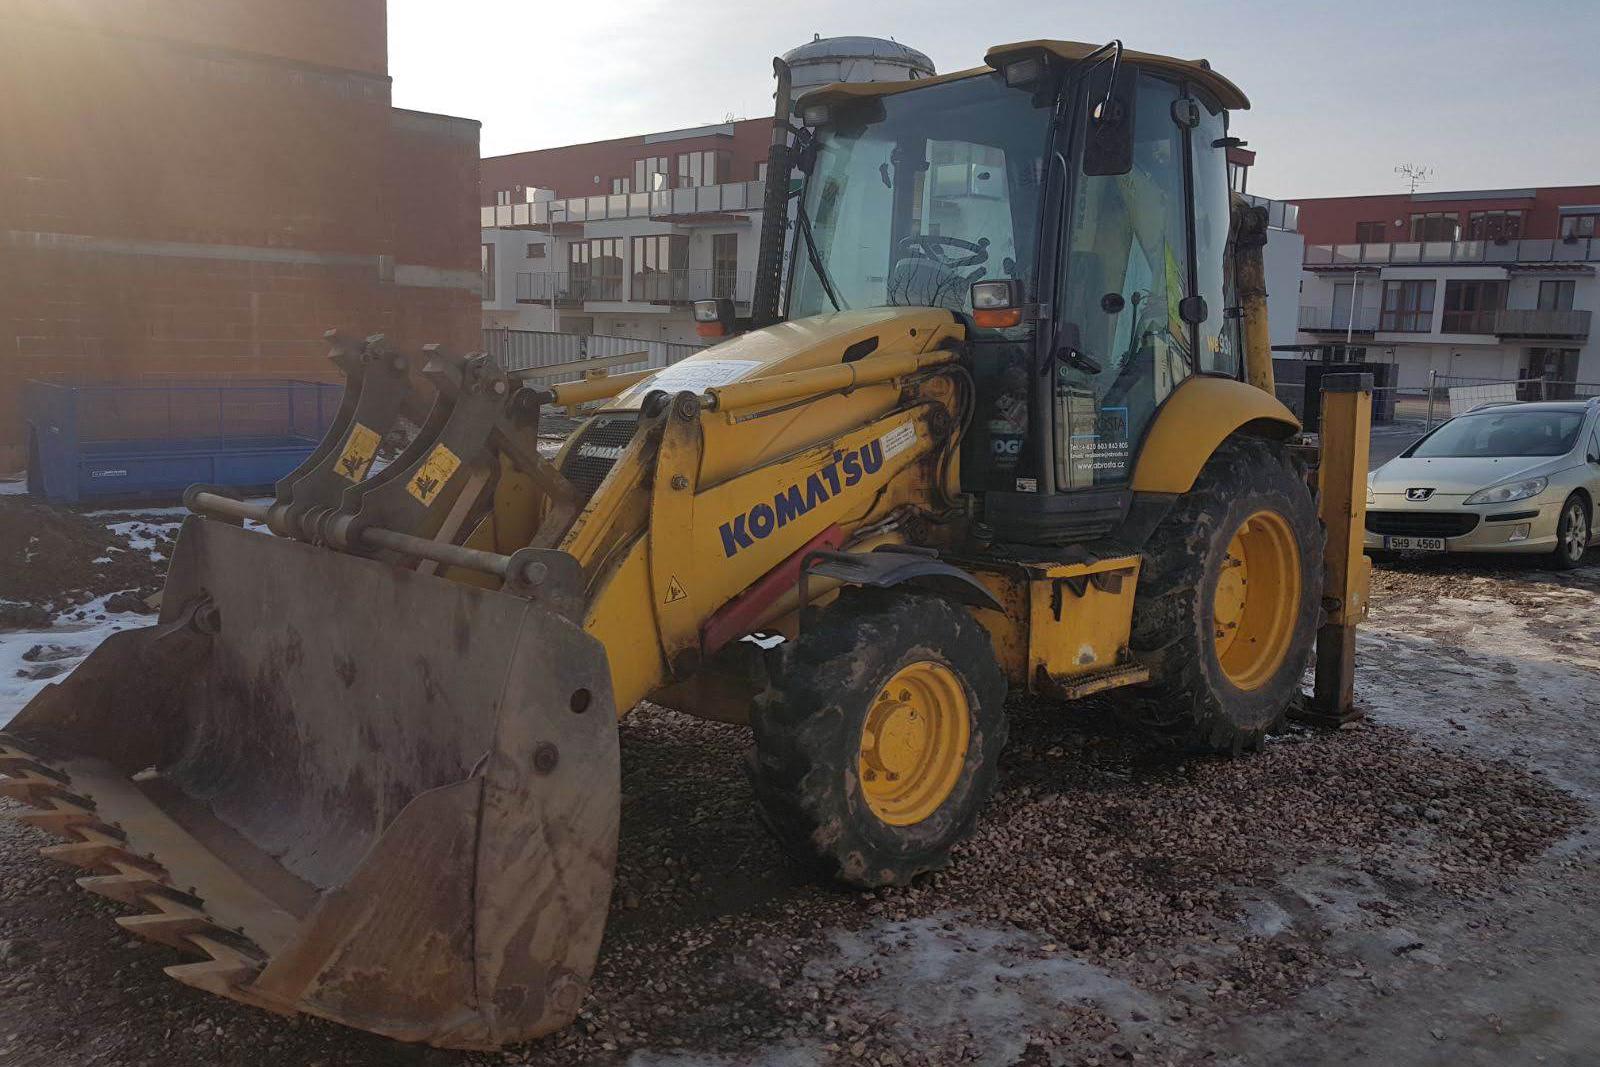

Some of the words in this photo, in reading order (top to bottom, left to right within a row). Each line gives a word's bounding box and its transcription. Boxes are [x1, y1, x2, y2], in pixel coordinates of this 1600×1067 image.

[718, 439, 884, 558] KOMATSU
[1391, 537, 1410, 548] 5H9
[1416, 538, 1441, 549] 4560
